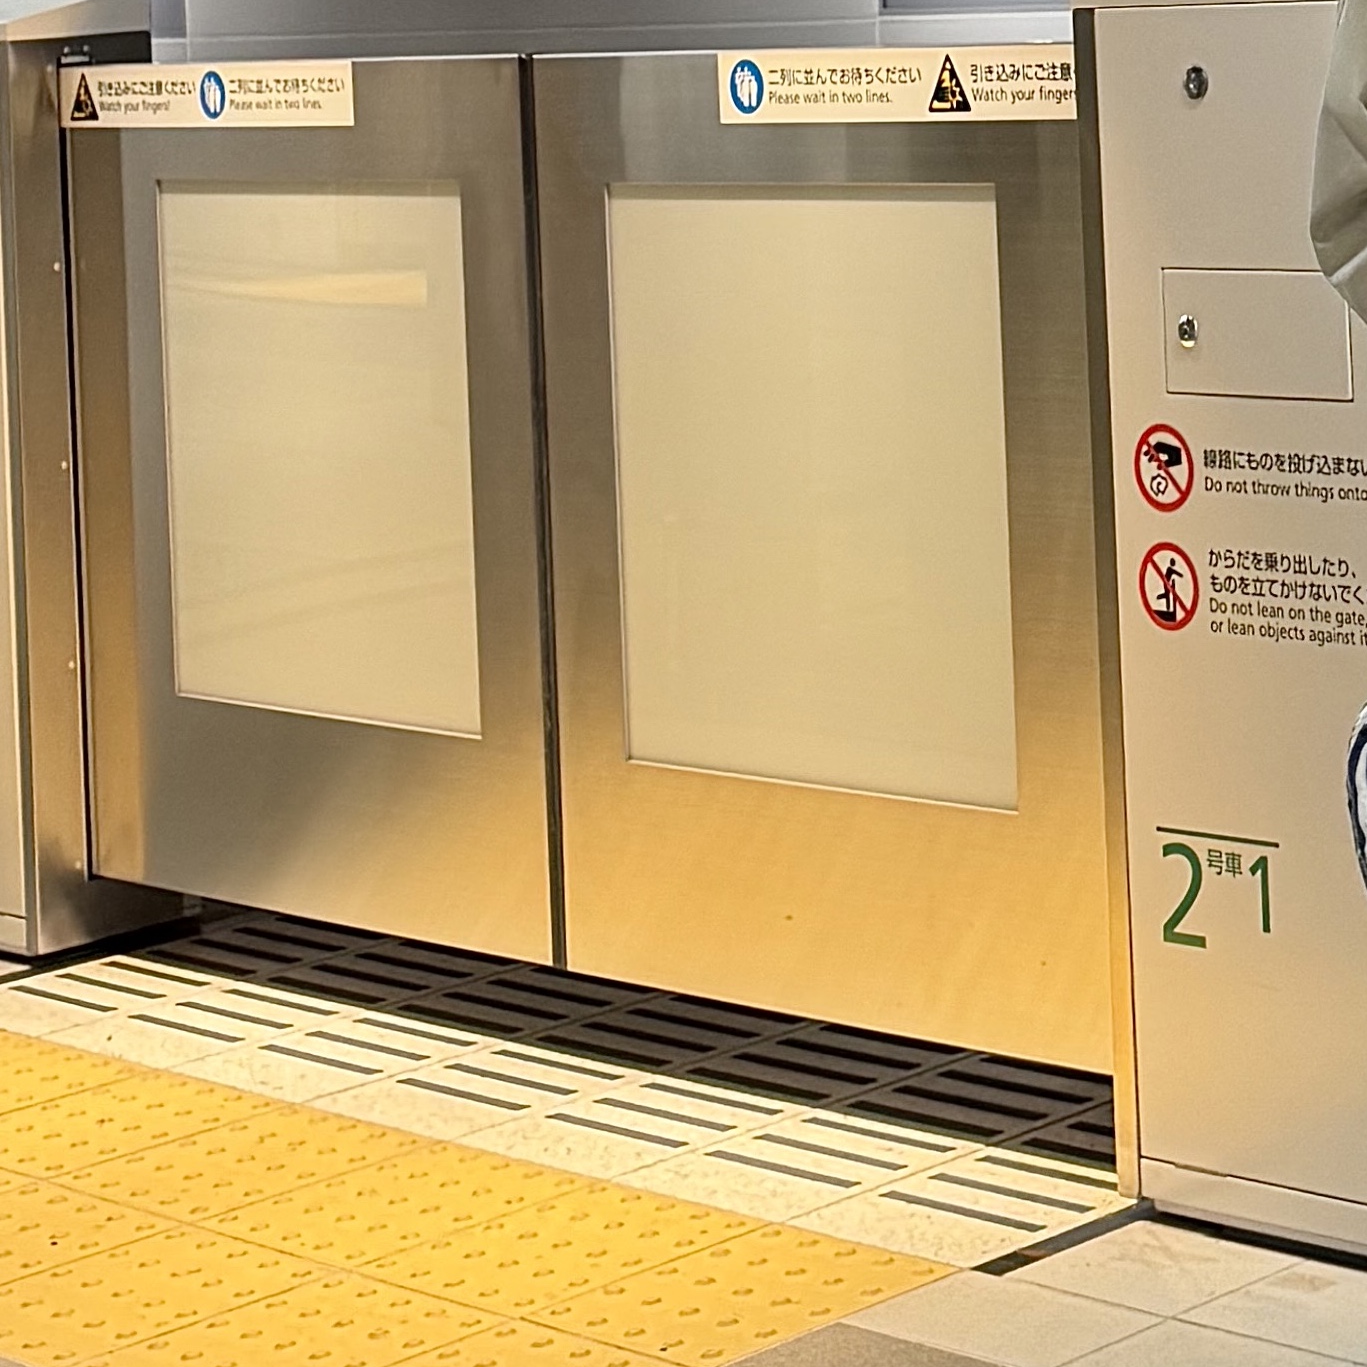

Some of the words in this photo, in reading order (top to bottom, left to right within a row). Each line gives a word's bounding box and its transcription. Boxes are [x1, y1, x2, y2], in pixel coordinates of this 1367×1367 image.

[768, 67, 922, 86] 二列に並んでお待ちください
[970, 62, 1075, 83] 引き込みにご注意
[768, 90, 800, 105] Please
[803, 90, 826, 104] wait
[829, 90, 839, 103] in
[842, 91, 863, 103] two
[866, 90, 892, 104] lines.
[972, 86, 1008, 103] Watch
[1011, 90, 1035, 105] your
[1040, 85, 1076, 105] finger
[1205, 476, 1222, 492] Do
[1226, 479, 1247, 494] not
[1252, 480, 1290, 496] throw
[1295, 483, 1334, 503] things
[1339, 488, 1367, 501] onto
[1209, 549, 1356, 579] からだを乗り出したり、
[1210, 598, 1227, 614] Do
[1232, 602, 1253, 616] not
[1258, 601, 1283, 618] lean
[1289, 608, 1305, 620] on
[1310, 606, 1331, 622] the
[1211, 620, 1224, 632] or
[1228, 620, 1255, 635] lean
[1259, 624, 1305, 642] objects
[1309, 627, 1355, 647] against
